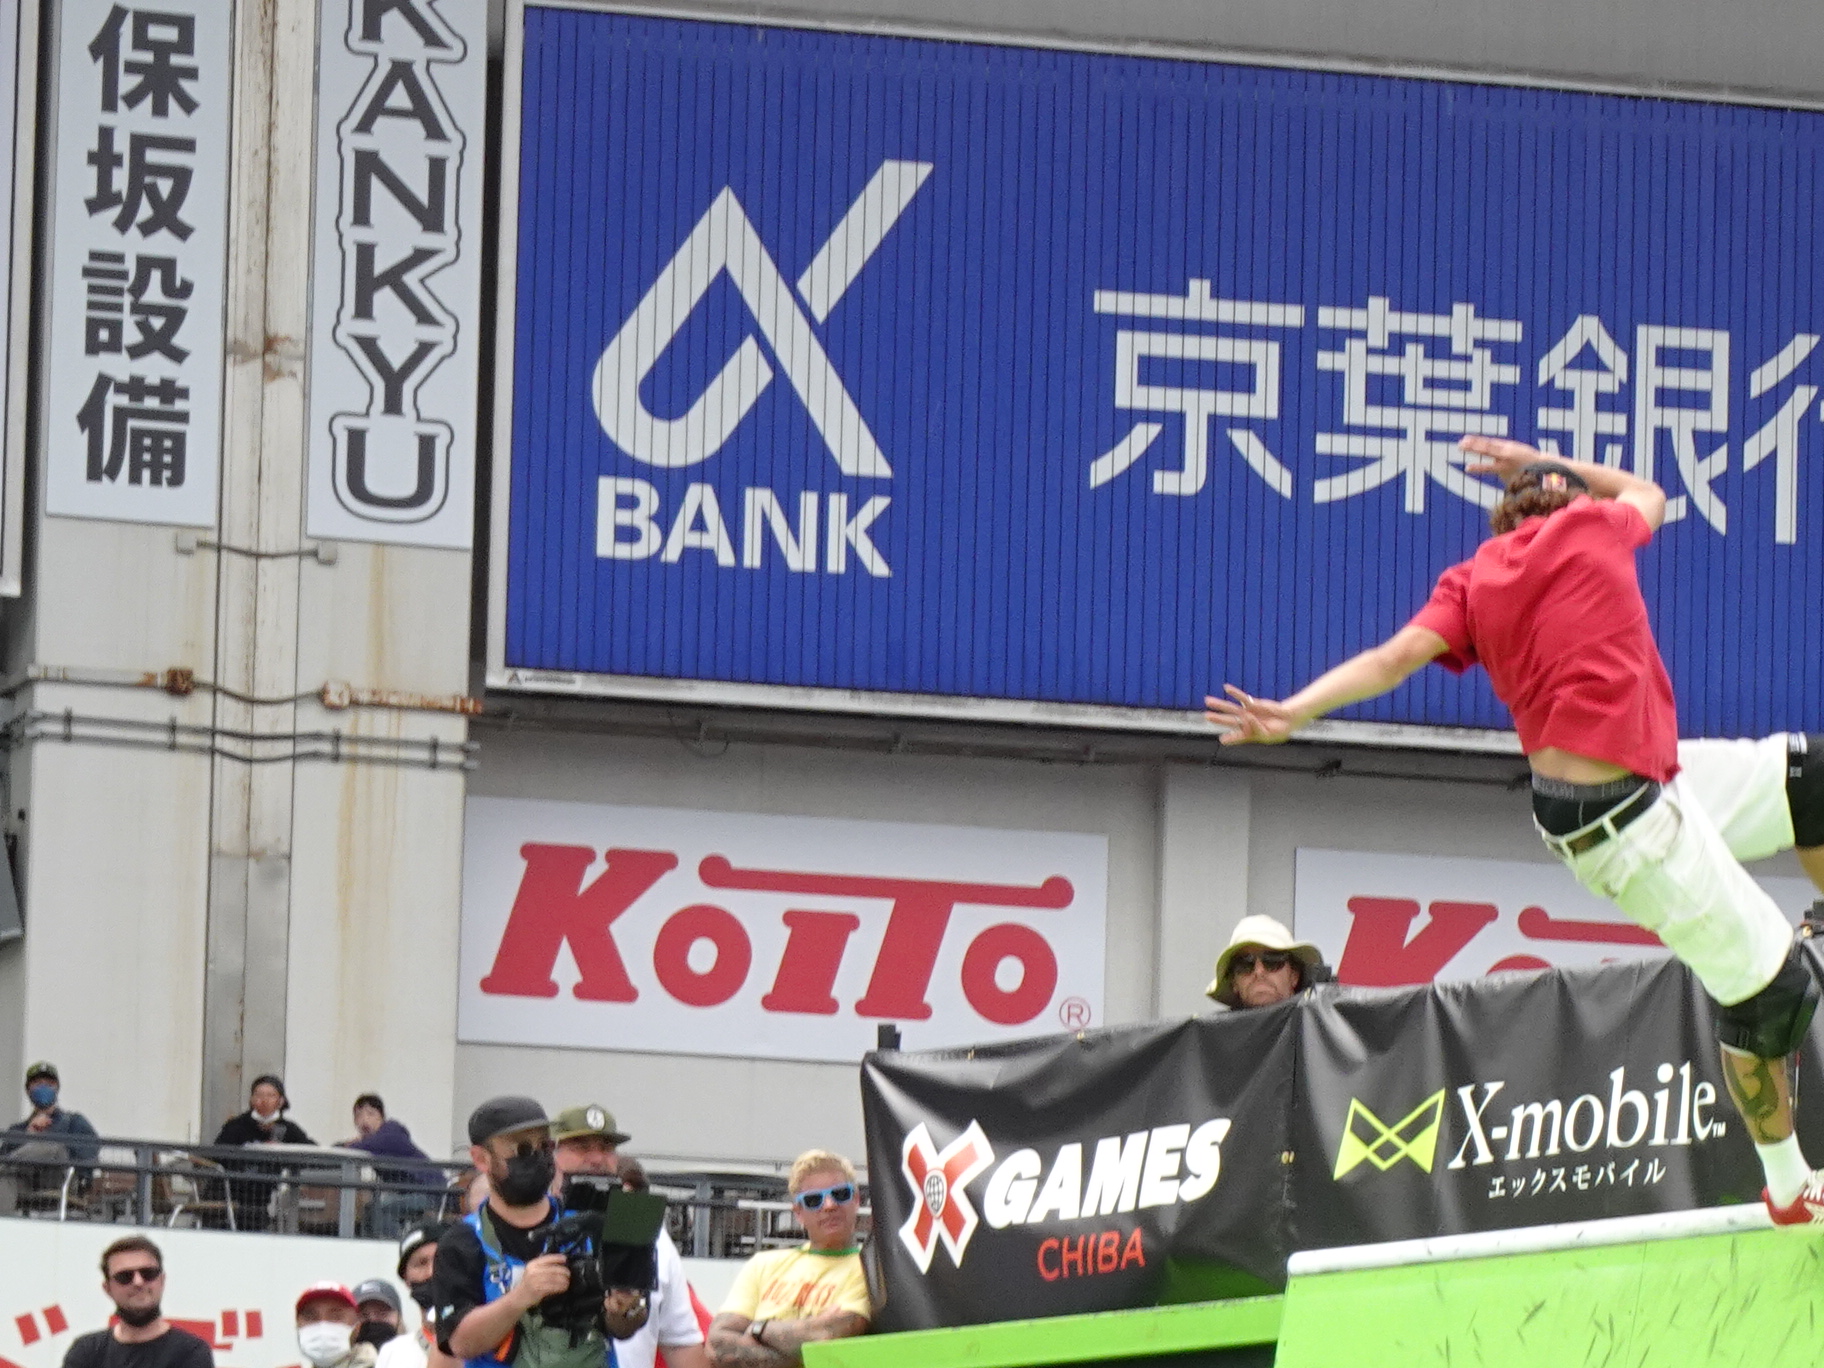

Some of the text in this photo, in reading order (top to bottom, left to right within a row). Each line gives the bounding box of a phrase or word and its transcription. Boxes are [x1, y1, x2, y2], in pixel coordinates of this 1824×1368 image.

[76, 4, 200, 488] 保坂設備
[596, 475, 892, 578] BANK
[983, 1118, 1231, 1229] GAMES
[1488, 1158, 1666, 1199] エックスモバイル
[1037, 1226, 1146, 1282] CHIBA
